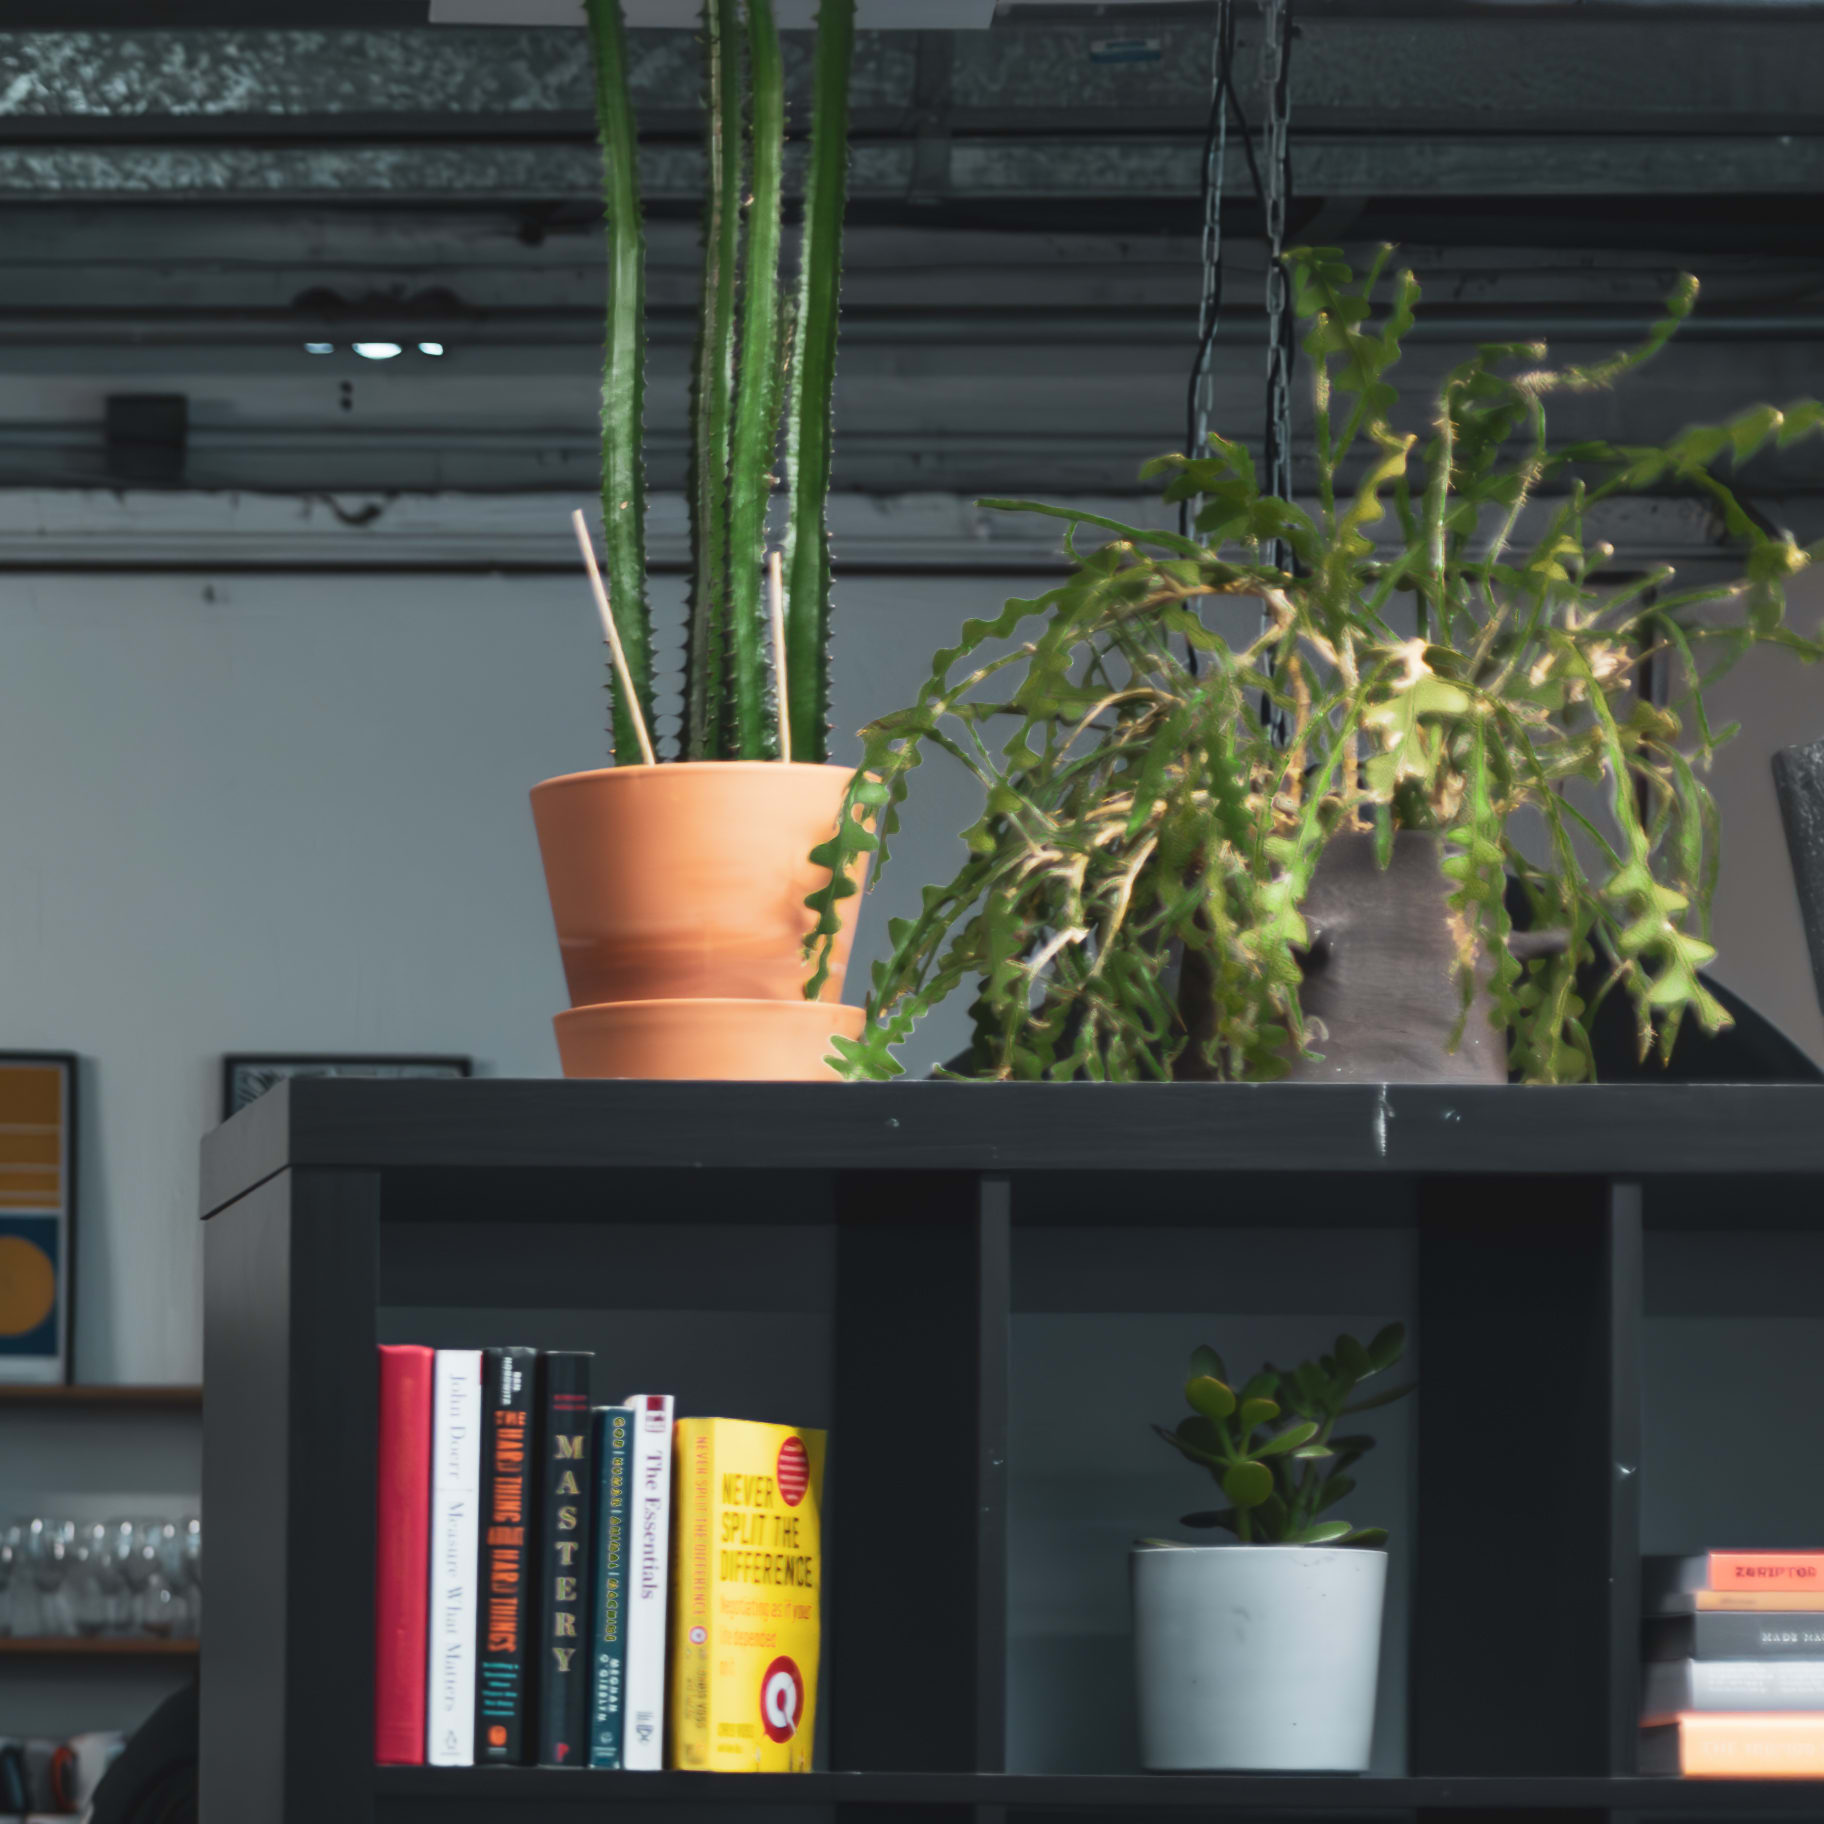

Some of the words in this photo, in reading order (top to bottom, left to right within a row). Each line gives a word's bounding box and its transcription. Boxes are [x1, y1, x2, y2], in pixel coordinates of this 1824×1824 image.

[448, 1373, 467, 1418] John
[448, 1425, 466, 1479] Doerr
[612, 1416, 626, 1448] GOD
[695, 1436, 709, 1475] NEVER
[610, 1457, 624, 1507] HUMAN
[644, 1450, 664, 1491] The
[722, 1472, 774, 1509] NEVER
[492, 1476, 523, 1523] THING
[694, 1479, 708, 1513] SPLIT
[446, 1501, 465, 1578] Measure
[607, 1516, 622, 1570] ANIMAL
[640, 1498, 662, 1600] Essentials
[693, 1517, 707, 1539] THE
[722, 1511, 767, 1547] SPLIT
[774, 1515, 800, 1549] THE
[551, 1434, 585, 1672] MASTERY
[720, 1549, 813, 1588] DIFFERENCE
[691, 1543, 707, 1616] DIFFERENCE
[445, 1586, 463, 1635] What
[487, 1597, 519, 1653] THINGS
[604, 1578, 619, 1643] MACHINE
[443, 1643, 462, 1712] Matters
[608, 1658, 621, 1713] MEGHAN
